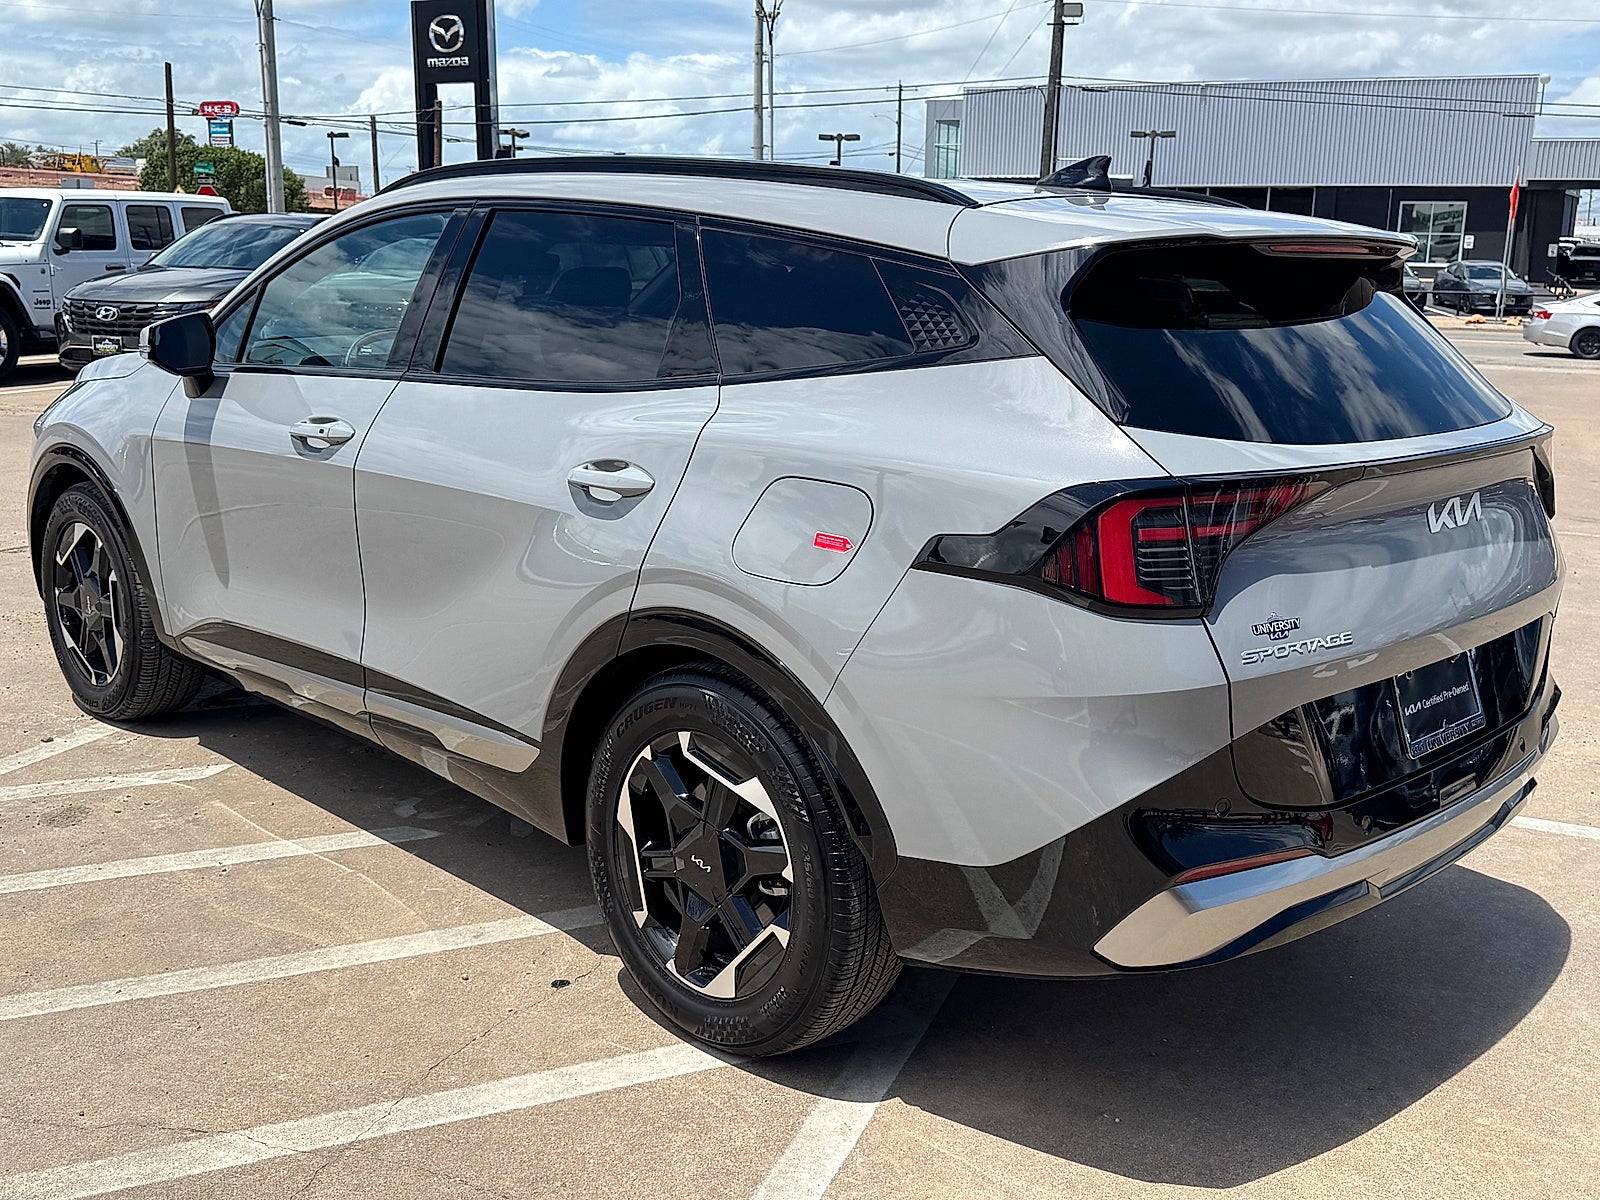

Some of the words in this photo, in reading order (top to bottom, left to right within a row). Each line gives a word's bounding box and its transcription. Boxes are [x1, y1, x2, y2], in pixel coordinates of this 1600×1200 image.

[33, 298, 51, 306] Jeep
[1426, 491, 1482, 534] KIA
[1252, 618, 1300, 635] UNIVERSITY
[1241, 631, 1353, 665] SPORTAGE
[1422, 692, 1443, 709] Certified
[1443, 681, 1470, 701] Pre-Owned
